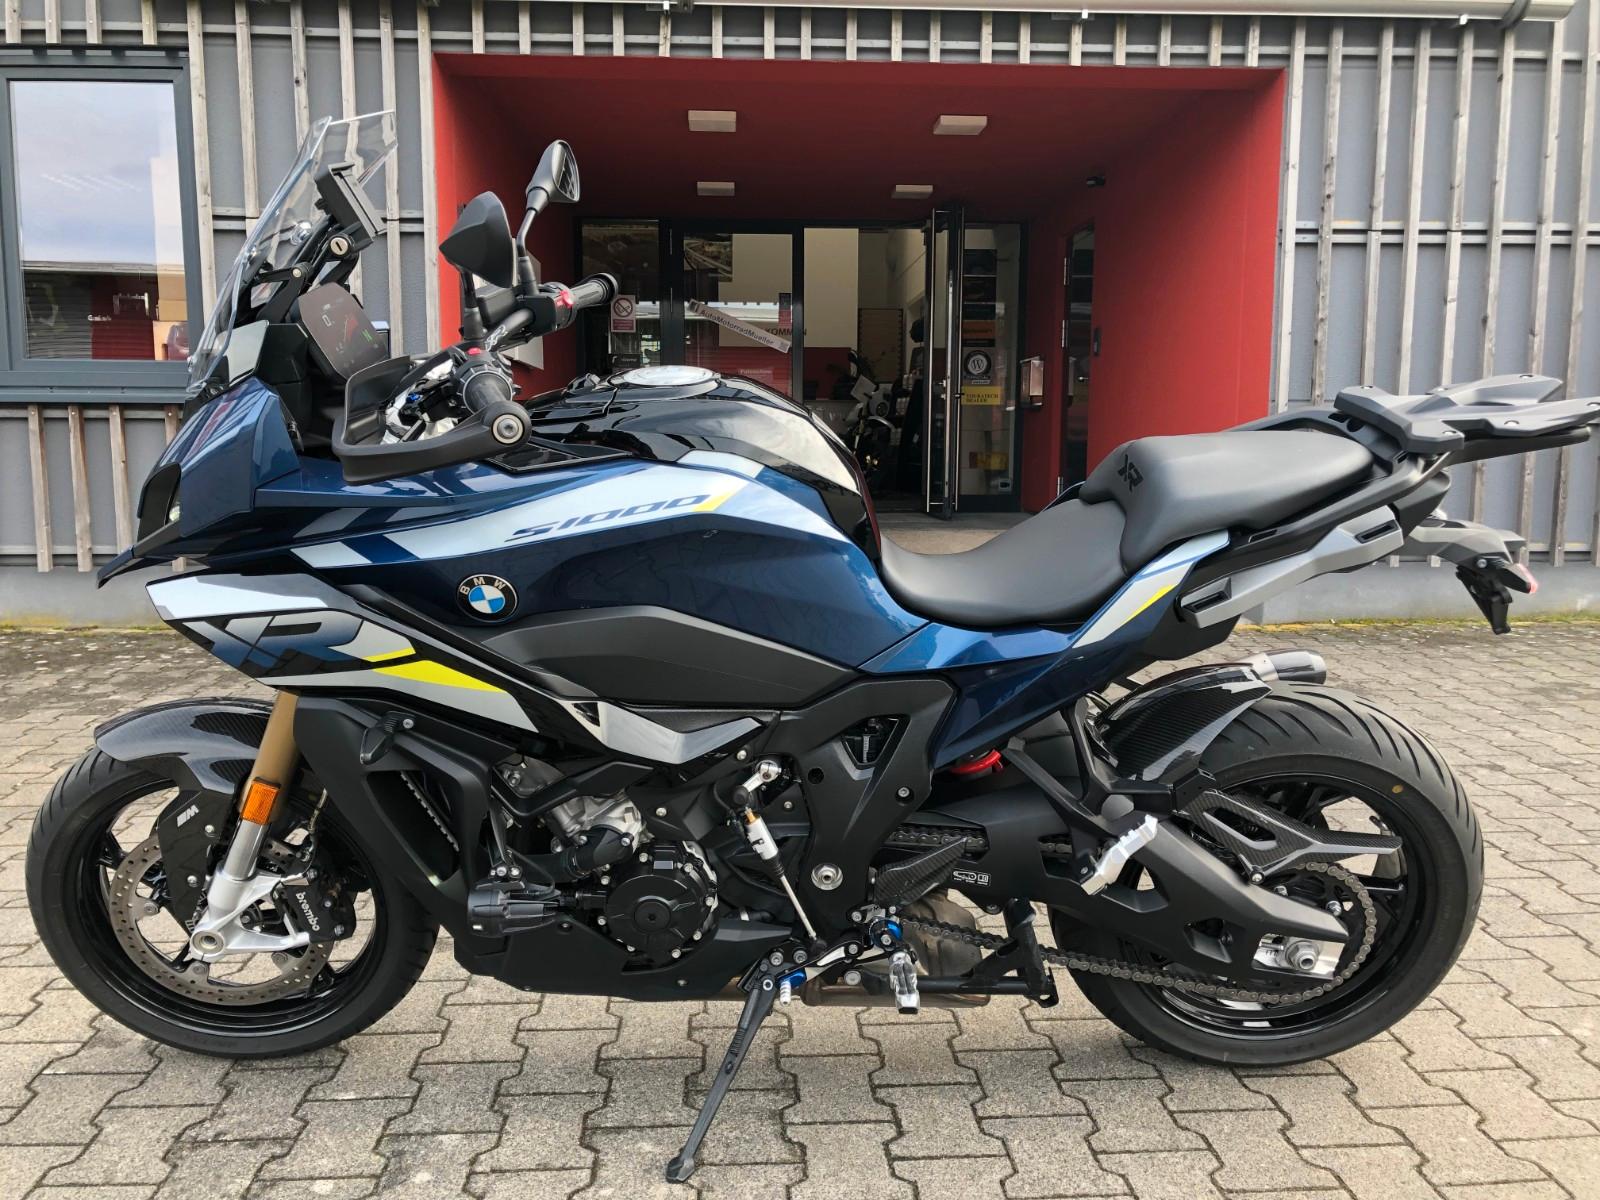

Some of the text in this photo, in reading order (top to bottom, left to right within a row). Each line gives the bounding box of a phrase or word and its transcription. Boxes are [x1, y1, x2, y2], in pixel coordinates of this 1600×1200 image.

[504, 494, 711, 542] S1000
[460, 576, 506, 595] BMW
[295, 891, 321, 932] brembo
